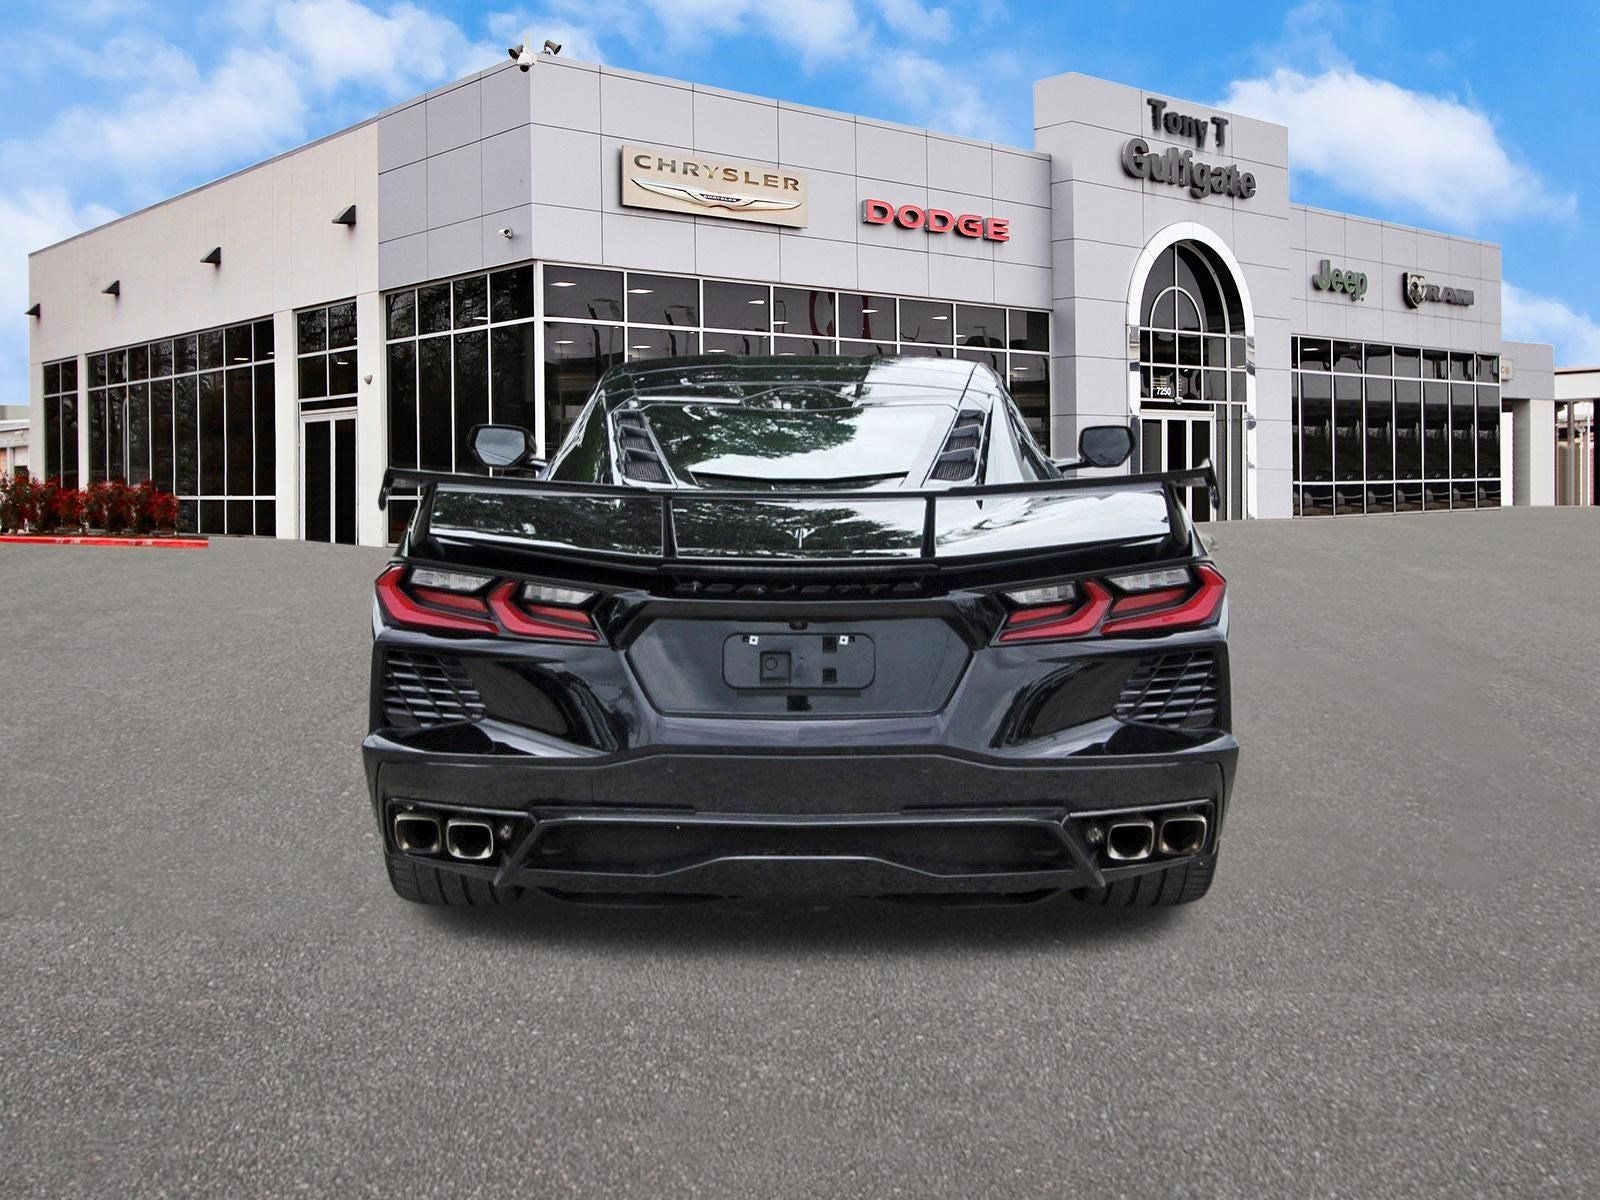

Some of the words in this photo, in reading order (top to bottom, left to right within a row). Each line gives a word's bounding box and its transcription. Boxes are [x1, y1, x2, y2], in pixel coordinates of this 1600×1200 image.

[1147, 98, 1208, 147] Tony
[1211, 116, 1229, 147] T
[634, 154, 800, 191] CHRYSLER
[1121, 138, 1256, 199] Gulfgate
[862, 198, 1010, 242] DODGE
[1312, 259, 1368, 301] Jeep
[1425, 283, 1474, 306] RAM
[1156, 386, 1171, 396] 7250
